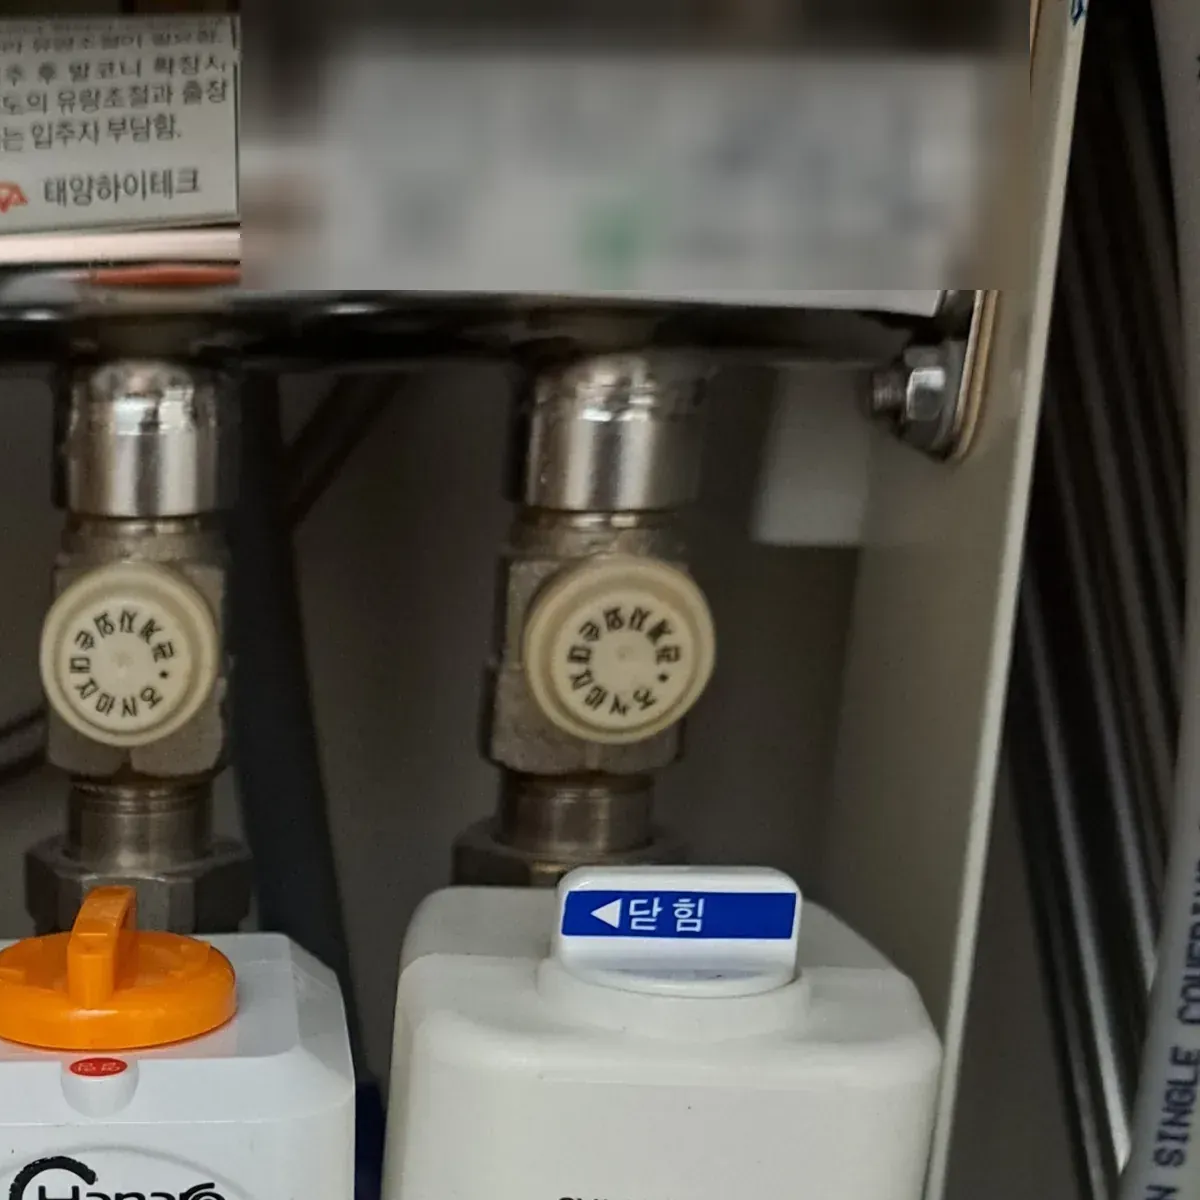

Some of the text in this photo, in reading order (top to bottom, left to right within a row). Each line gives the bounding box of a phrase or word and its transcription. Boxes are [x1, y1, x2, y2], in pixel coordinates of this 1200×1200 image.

[31, 118, 99, 149] 입주자
[44, 171, 201, 206] 태양하이테크
[628, 896, 706, 933] 닫힘
[1153, 1045, 1200, 1169] SINGLE
